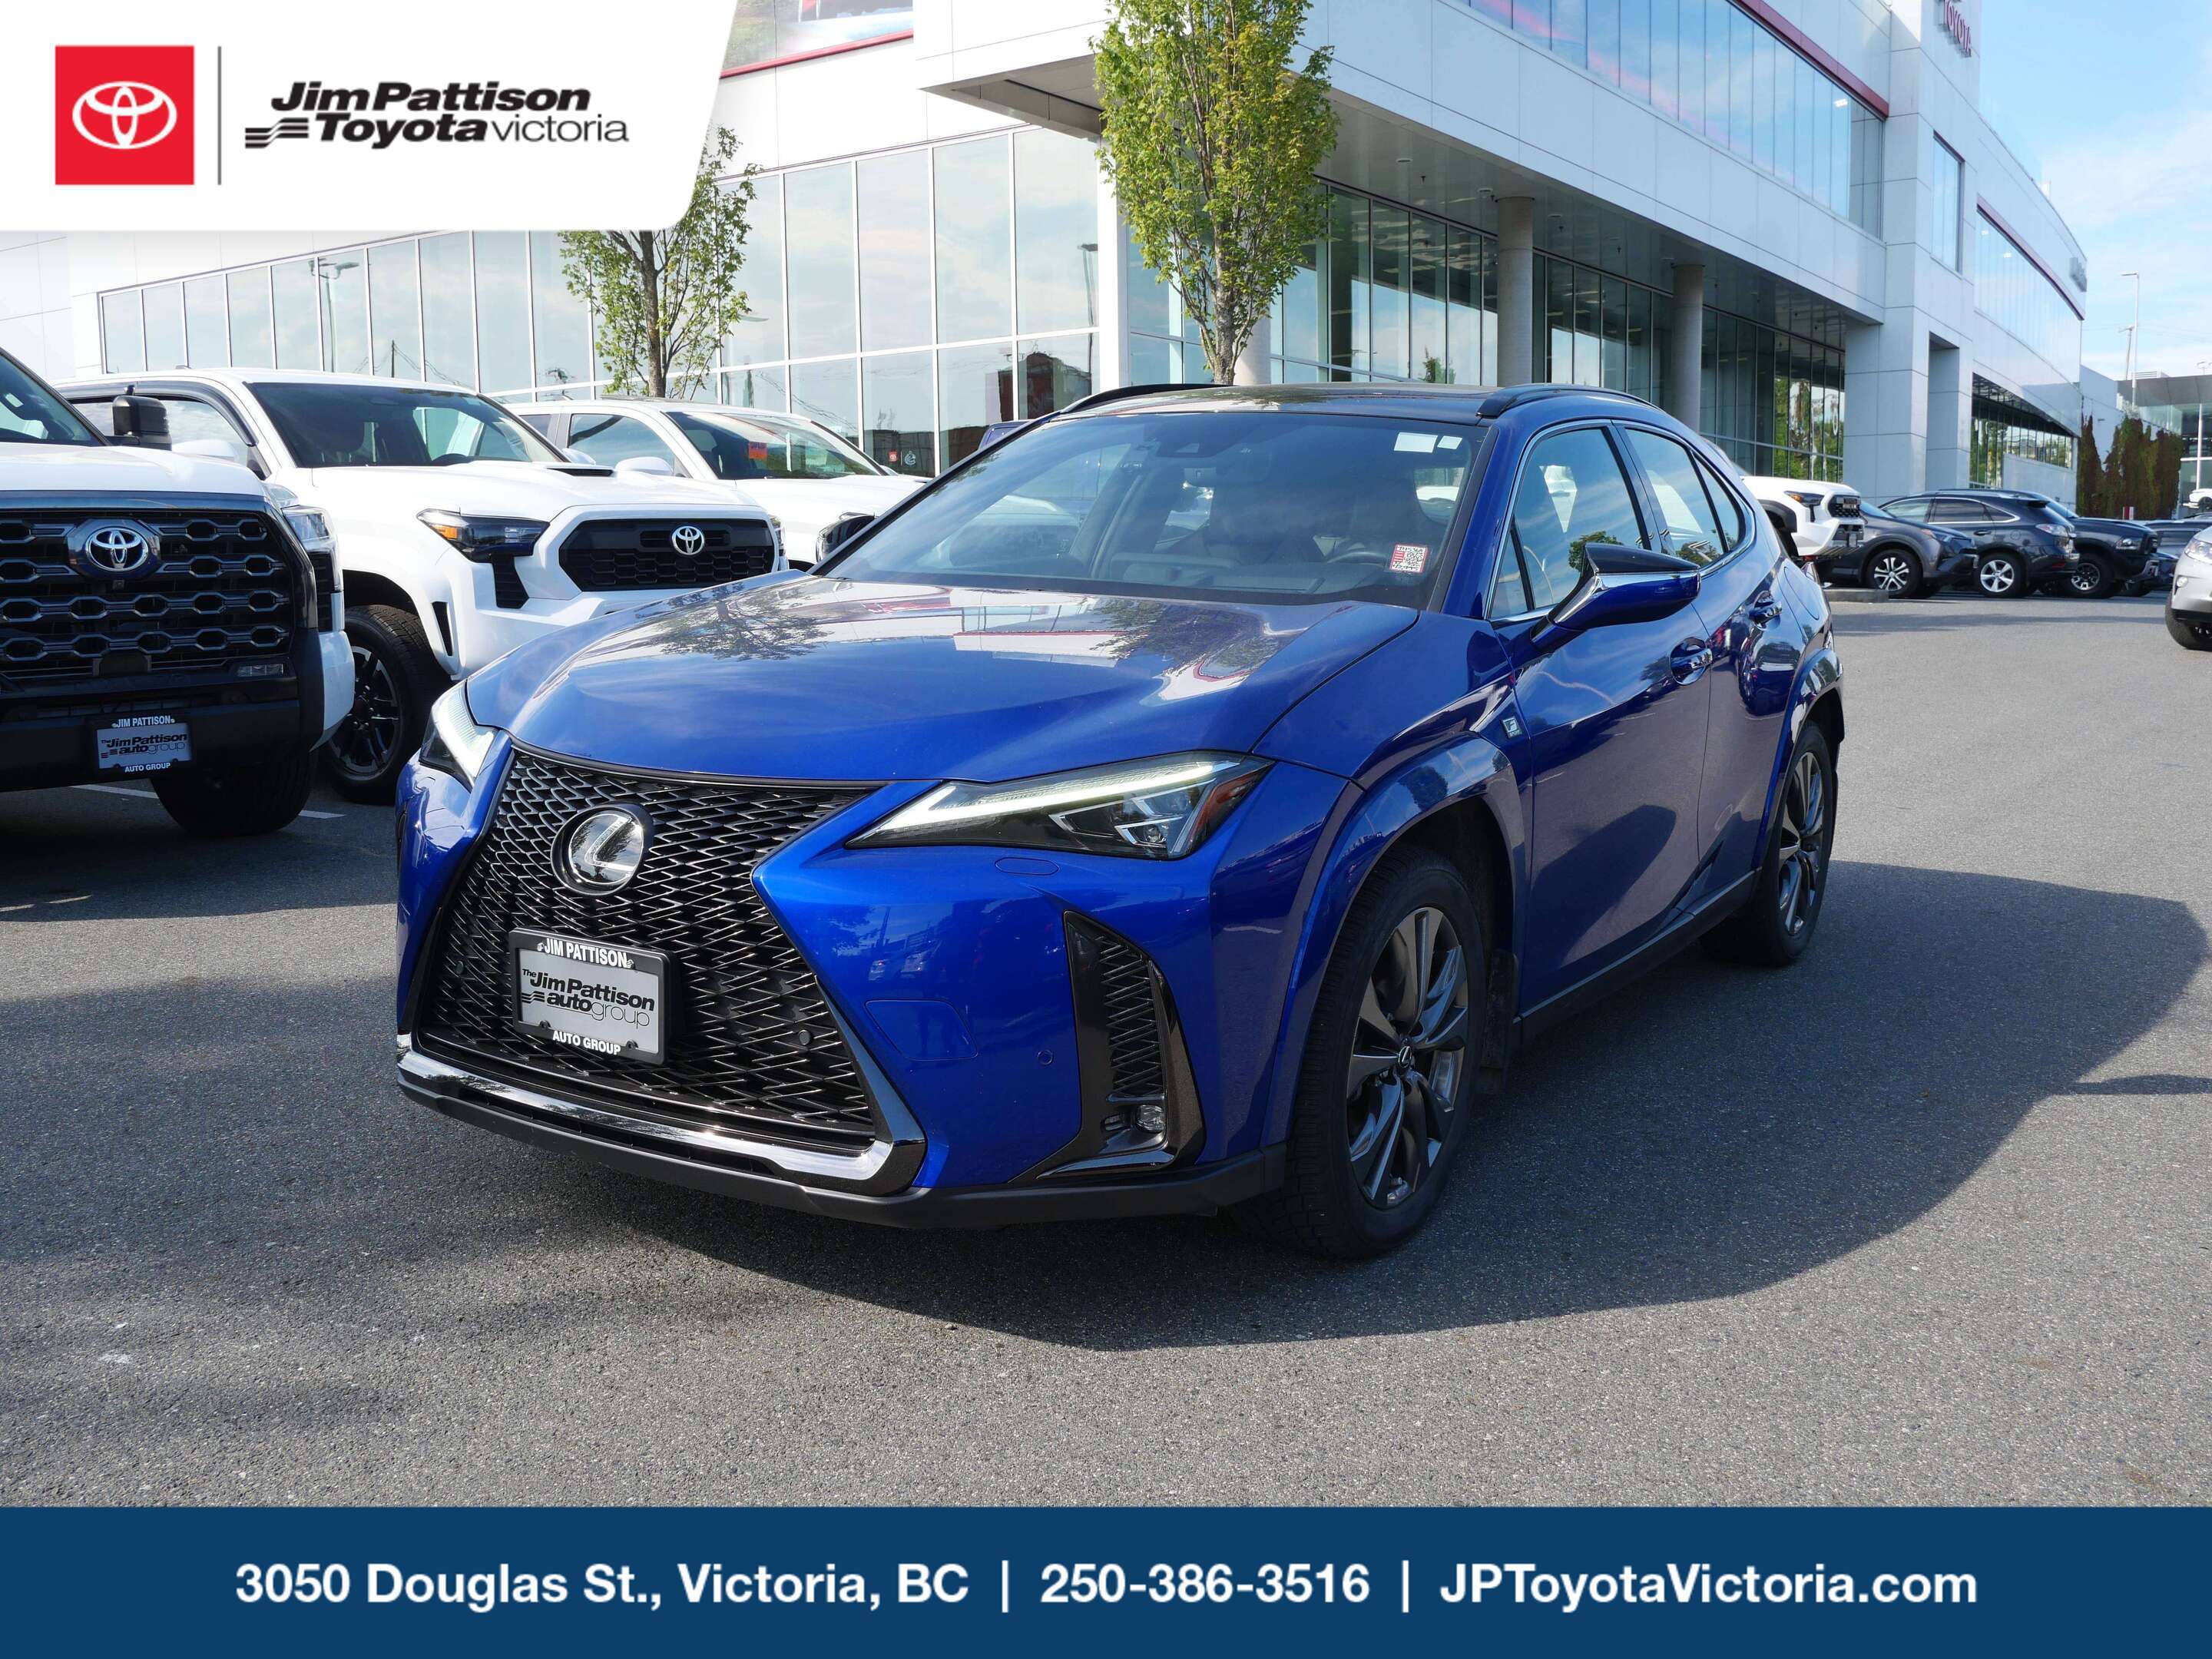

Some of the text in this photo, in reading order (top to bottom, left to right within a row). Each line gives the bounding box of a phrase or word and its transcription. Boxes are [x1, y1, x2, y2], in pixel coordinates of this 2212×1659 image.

[116, 715, 171, 728] JIM PATTISON
[106, 738, 131, 748] Jim
[131, 733, 187, 747] Pattison
[124, 763, 171, 773] AUTO GROUP
[545, 938, 628, 969] JIM PATTISON
[522, 969, 655, 1012] The Jim Pattison
[552, 1030, 621, 1055] AUTO GROUP
